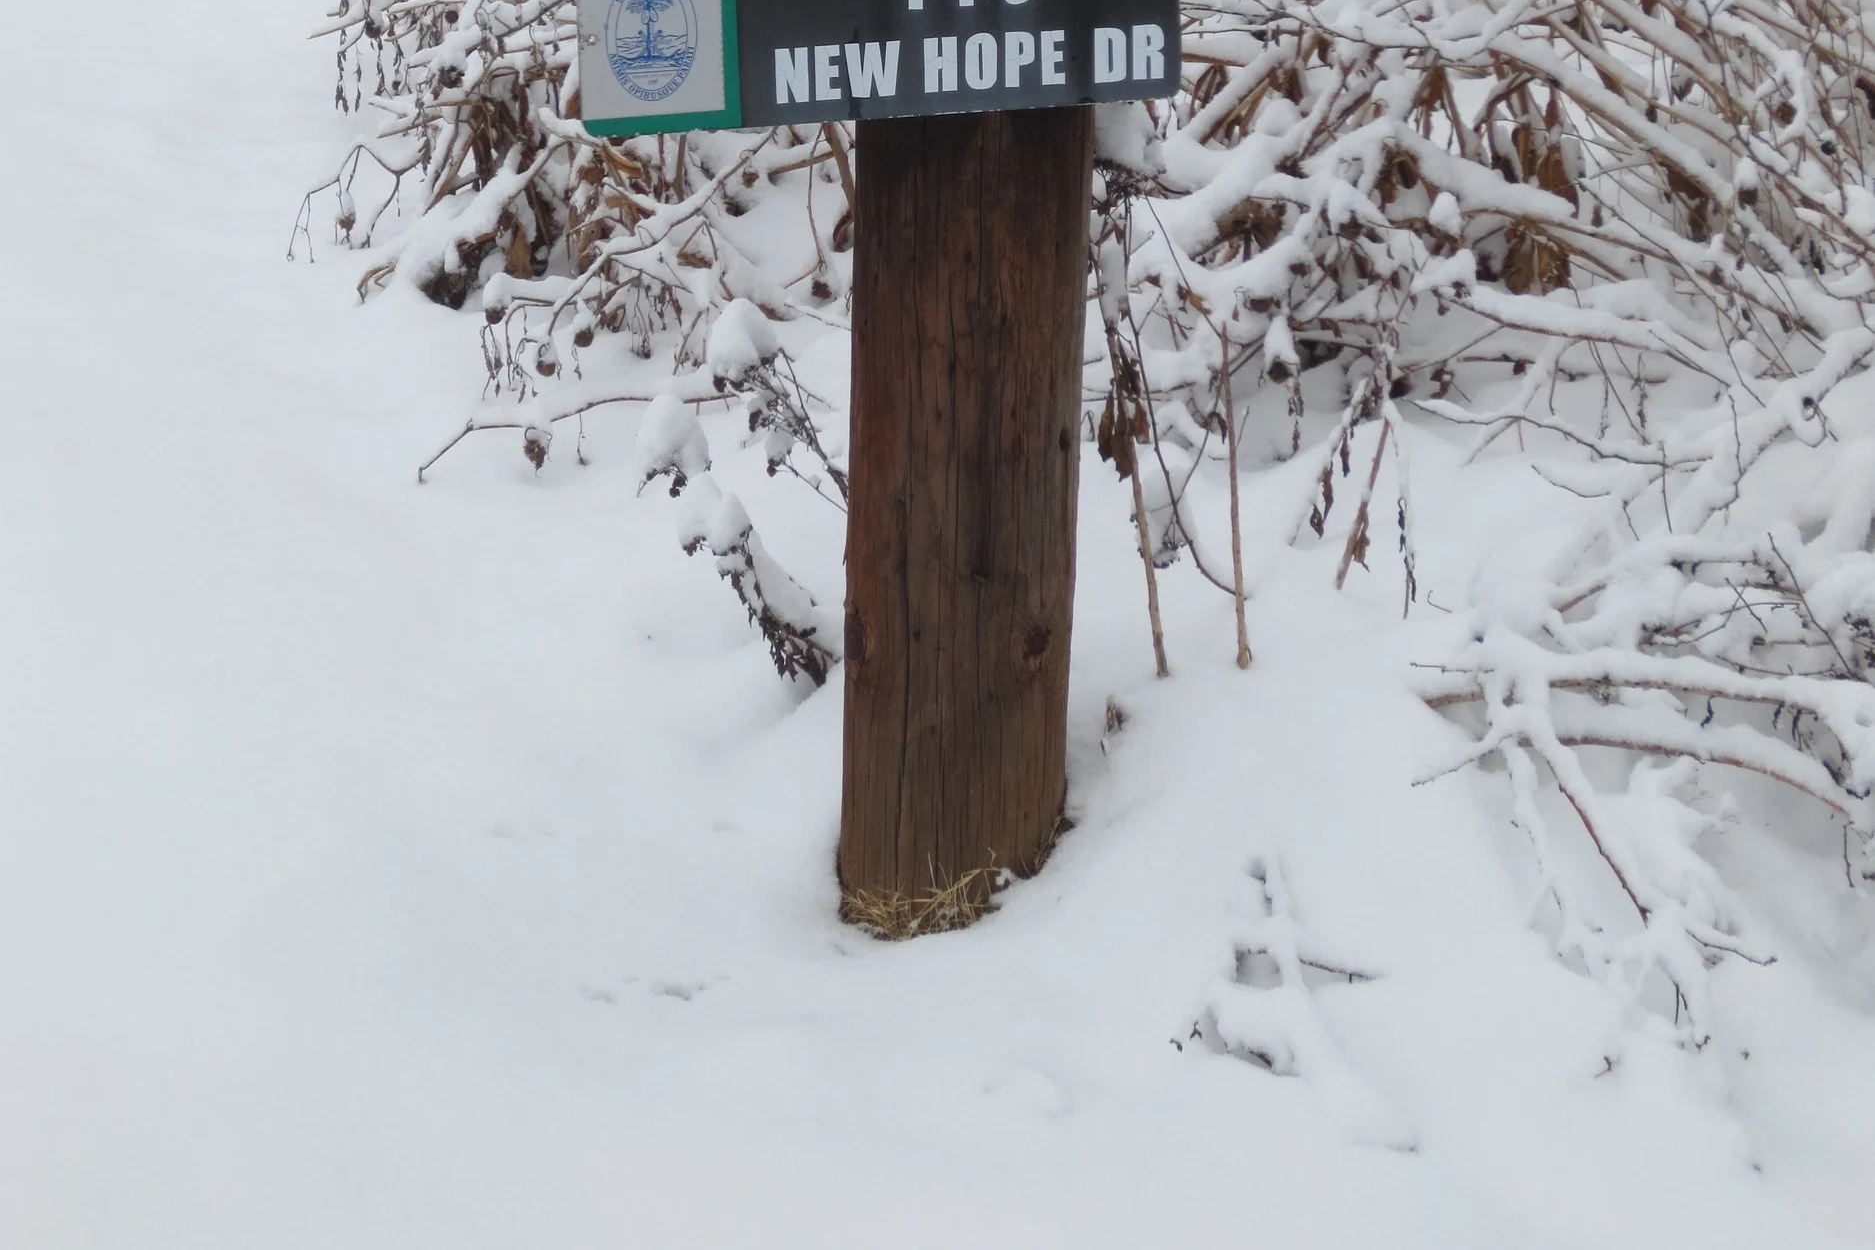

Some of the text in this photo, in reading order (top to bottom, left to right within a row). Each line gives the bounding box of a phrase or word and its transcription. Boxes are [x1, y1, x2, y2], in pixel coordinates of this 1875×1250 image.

[774, 24, 1165, 104] NEW HOPE DR
